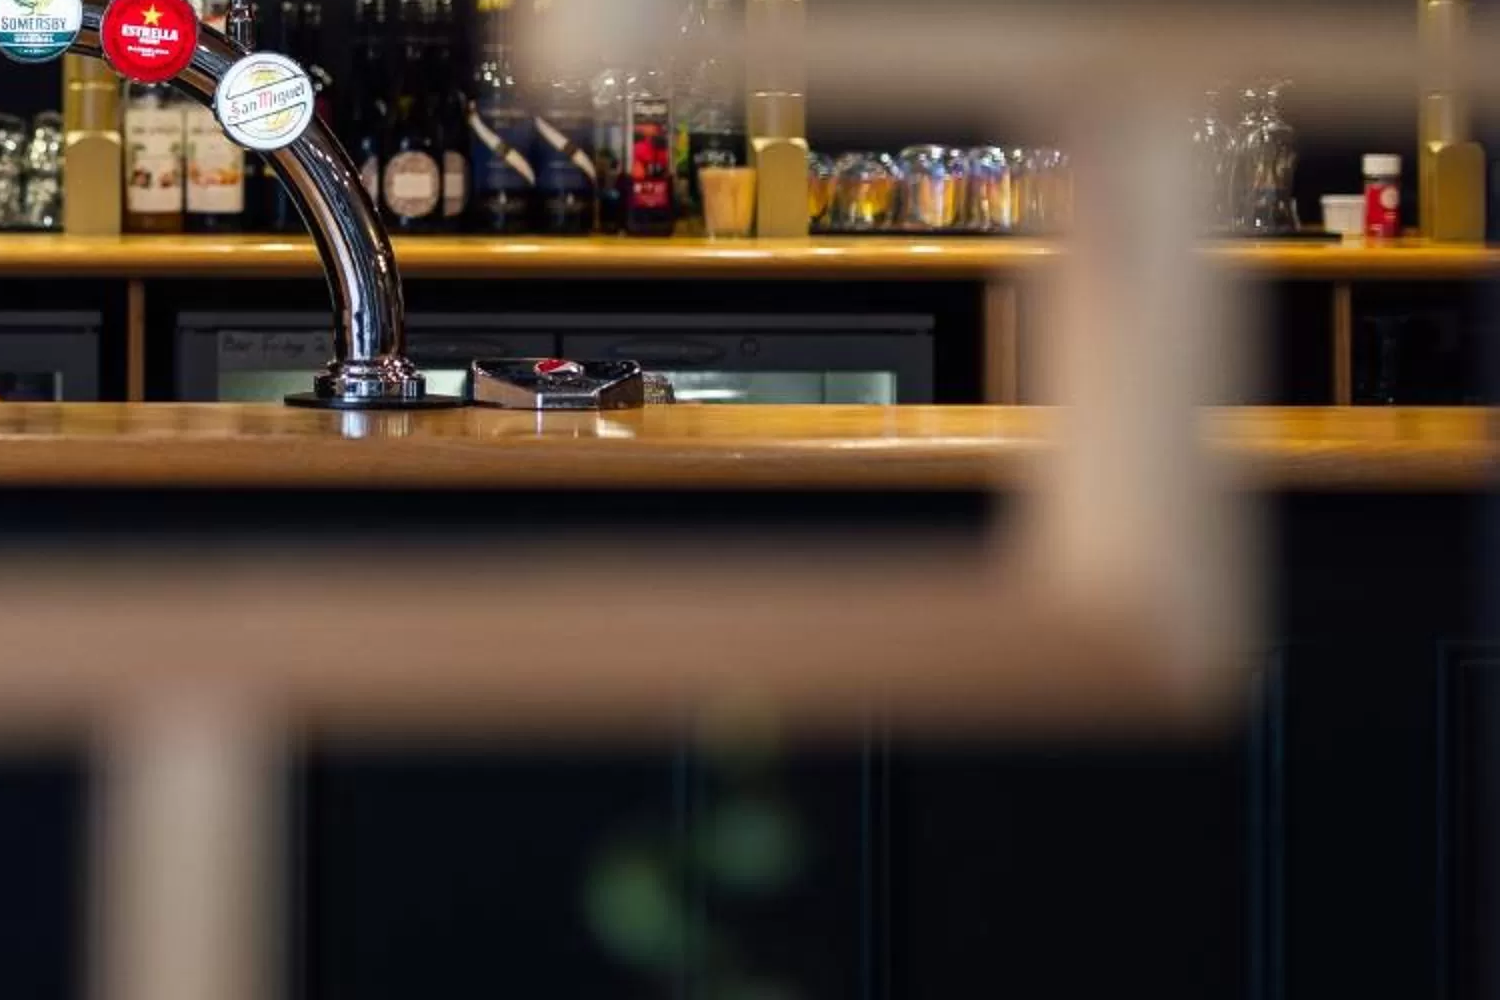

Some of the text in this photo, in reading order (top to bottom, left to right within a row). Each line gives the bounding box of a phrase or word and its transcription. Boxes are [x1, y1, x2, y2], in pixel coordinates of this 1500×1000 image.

[1, 17, 66, 31] SOMERSBY
[121, 23, 179, 42] ESTRELLA
[228, 82, 305, 120] San Miguel
